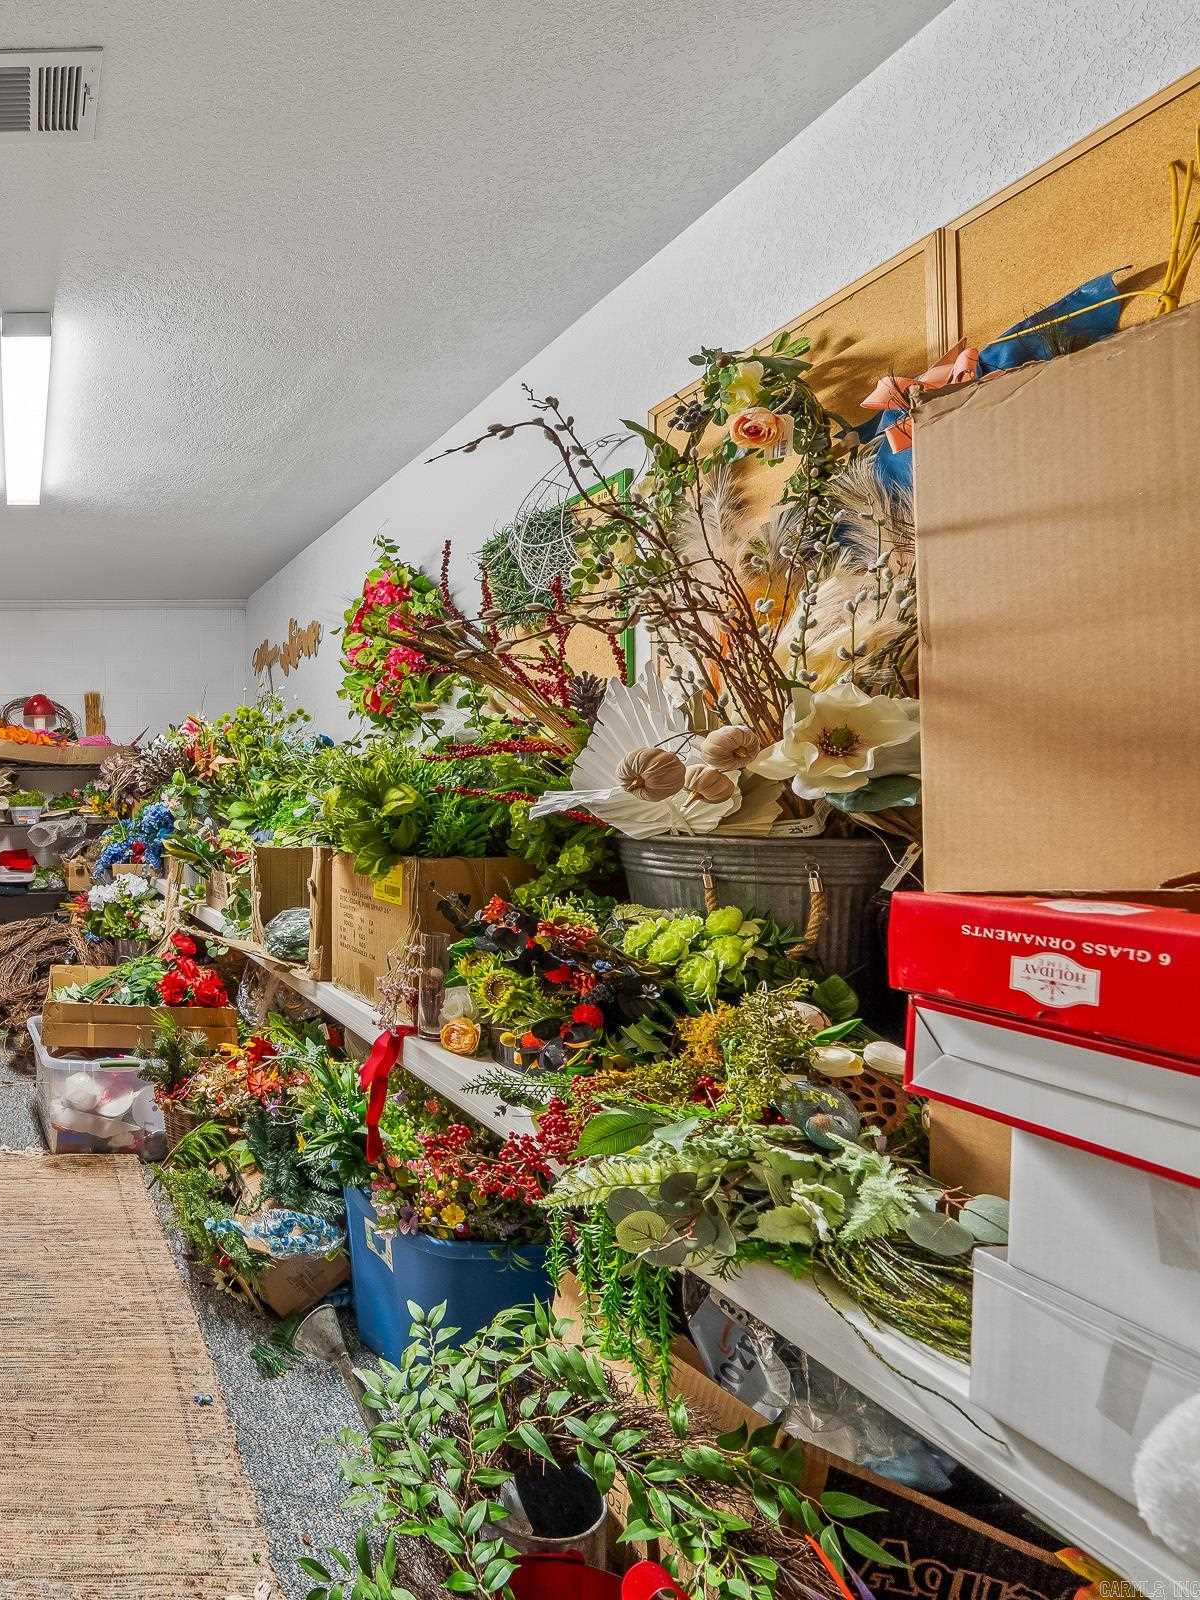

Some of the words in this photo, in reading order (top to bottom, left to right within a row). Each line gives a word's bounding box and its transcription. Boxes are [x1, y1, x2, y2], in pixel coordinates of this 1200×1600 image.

[961, 924, 1076, 951] ORNAMENTS
[1082, 941, 1151, 963] GLASS
[1158, 952, 1172, 966] 6
[1022, 963, 1087, 984] HOLIDAY
